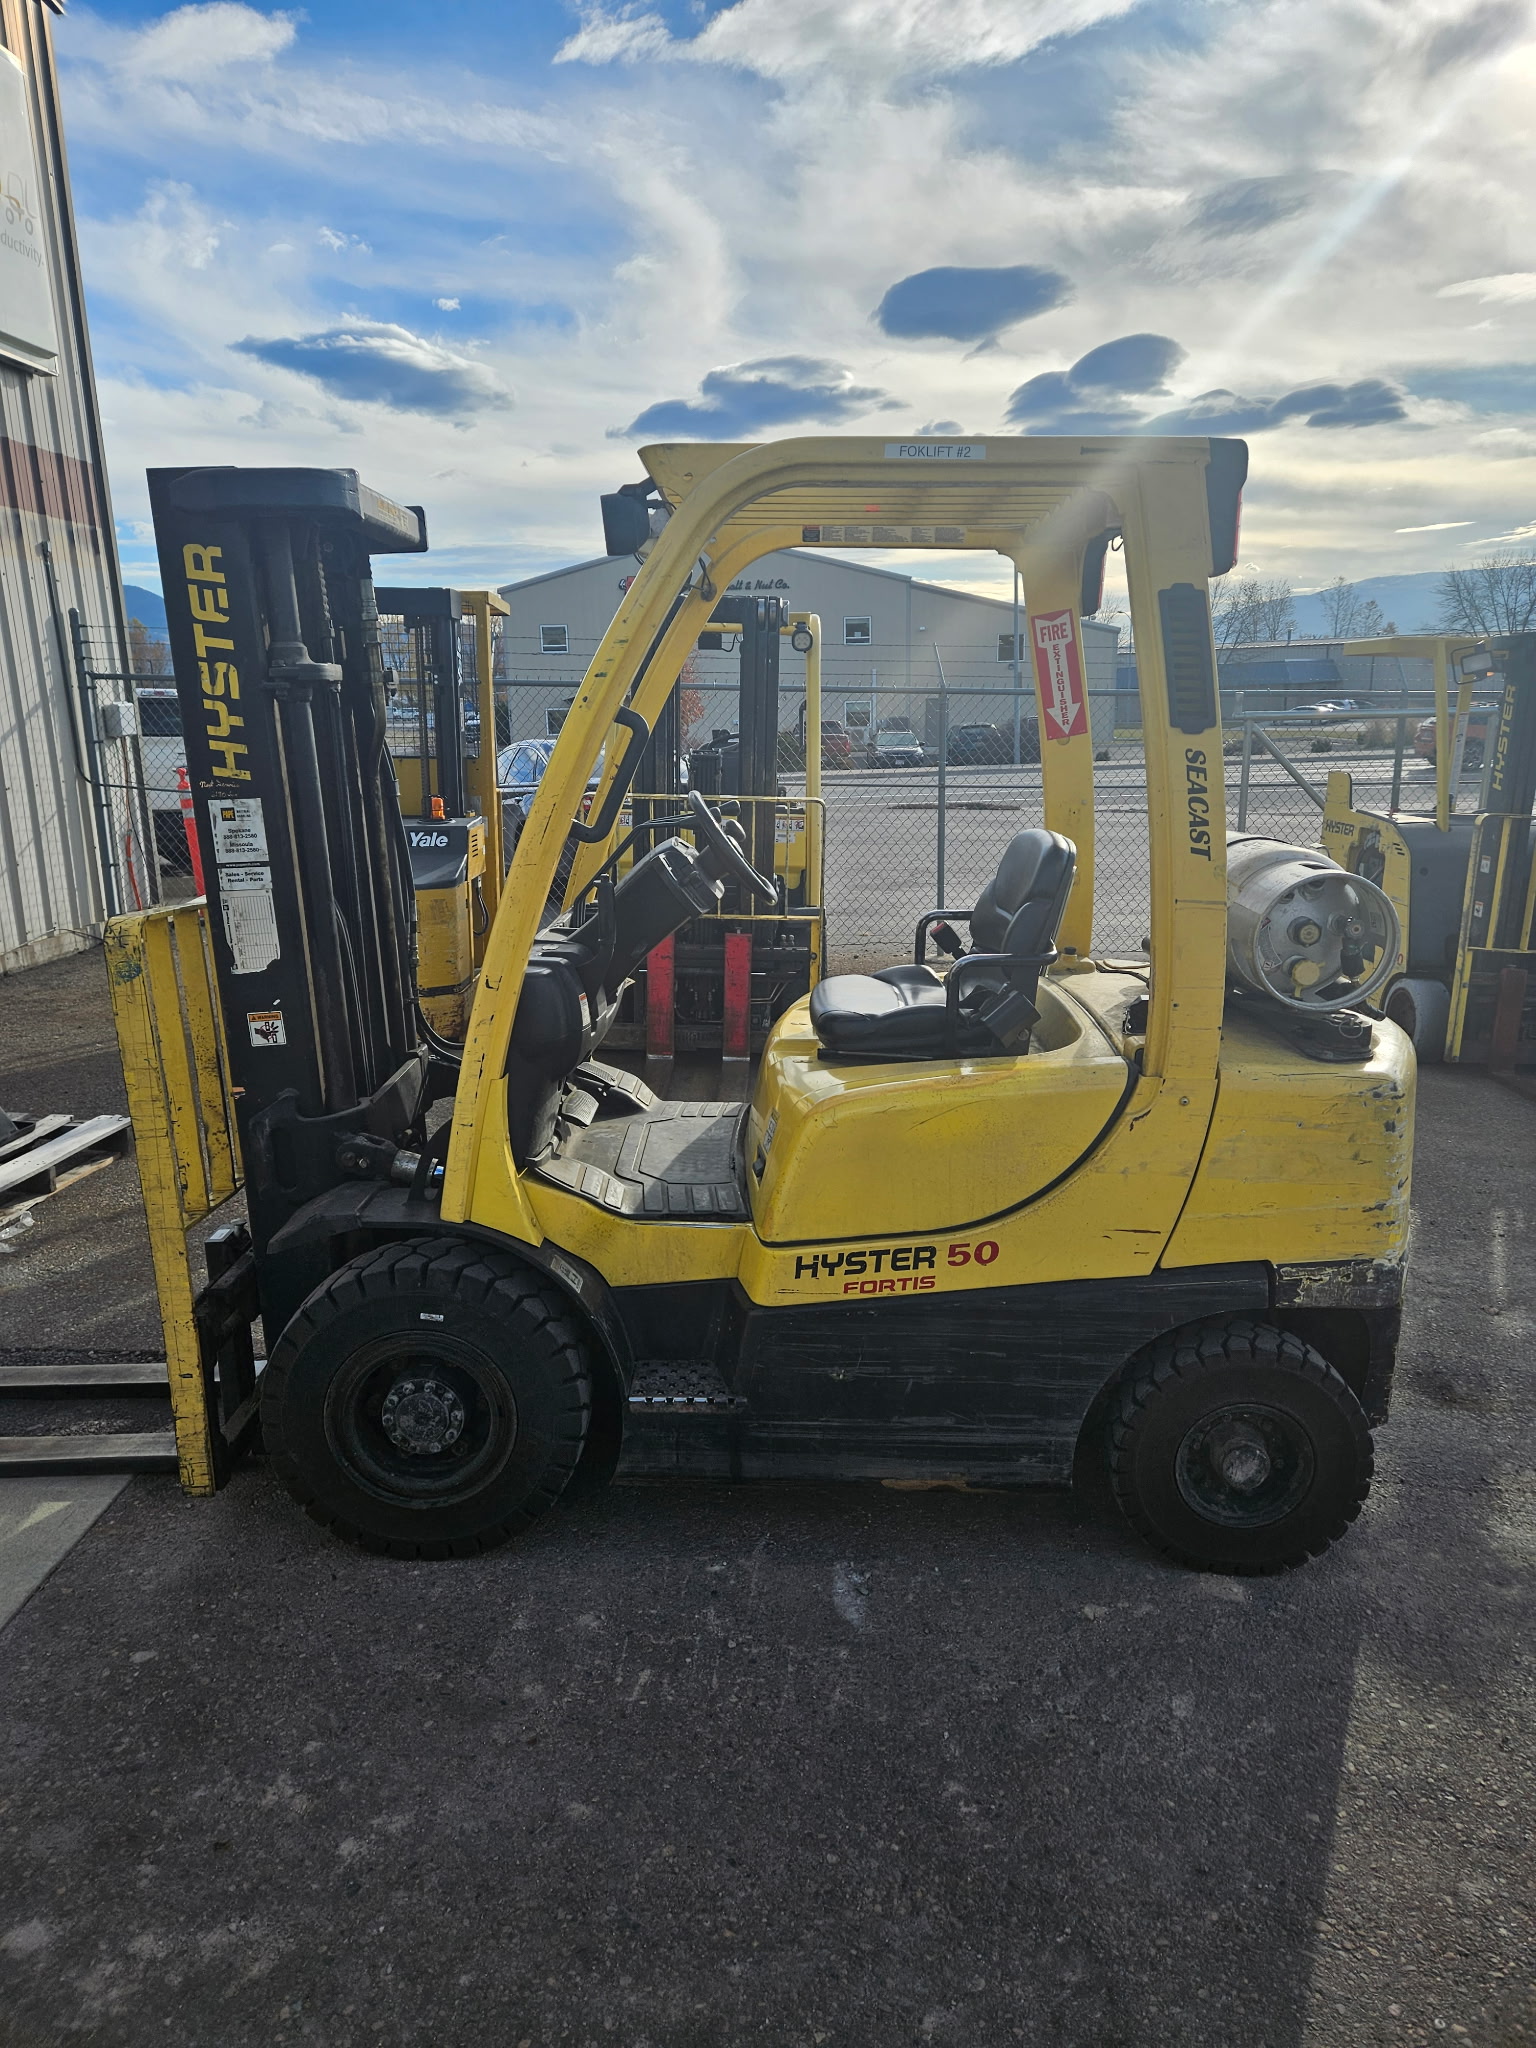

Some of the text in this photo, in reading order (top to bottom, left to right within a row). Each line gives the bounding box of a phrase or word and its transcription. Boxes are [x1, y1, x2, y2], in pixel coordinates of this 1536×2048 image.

[899, 445, 971, 458] FOKLIFT #2
[726, 578, 790, 591] olt & Nut Co.
[1039, 622, 1069, 643] FIRE
[182, 543, 252, 781] HYSTER
[1052, 643, 1070, 726] EXTINGUISHER
[1492, 684, 1517, 791] HYSTER
[1185, 748, 1212, 862] SEACAST
[1325, 819, 1355, 837] HYSTER
[409, 831, 448, 847] Yale
[794, 1240, 1000, 1279] HYSTER 50
[843, 1275, 936, 1294] FORTIS
